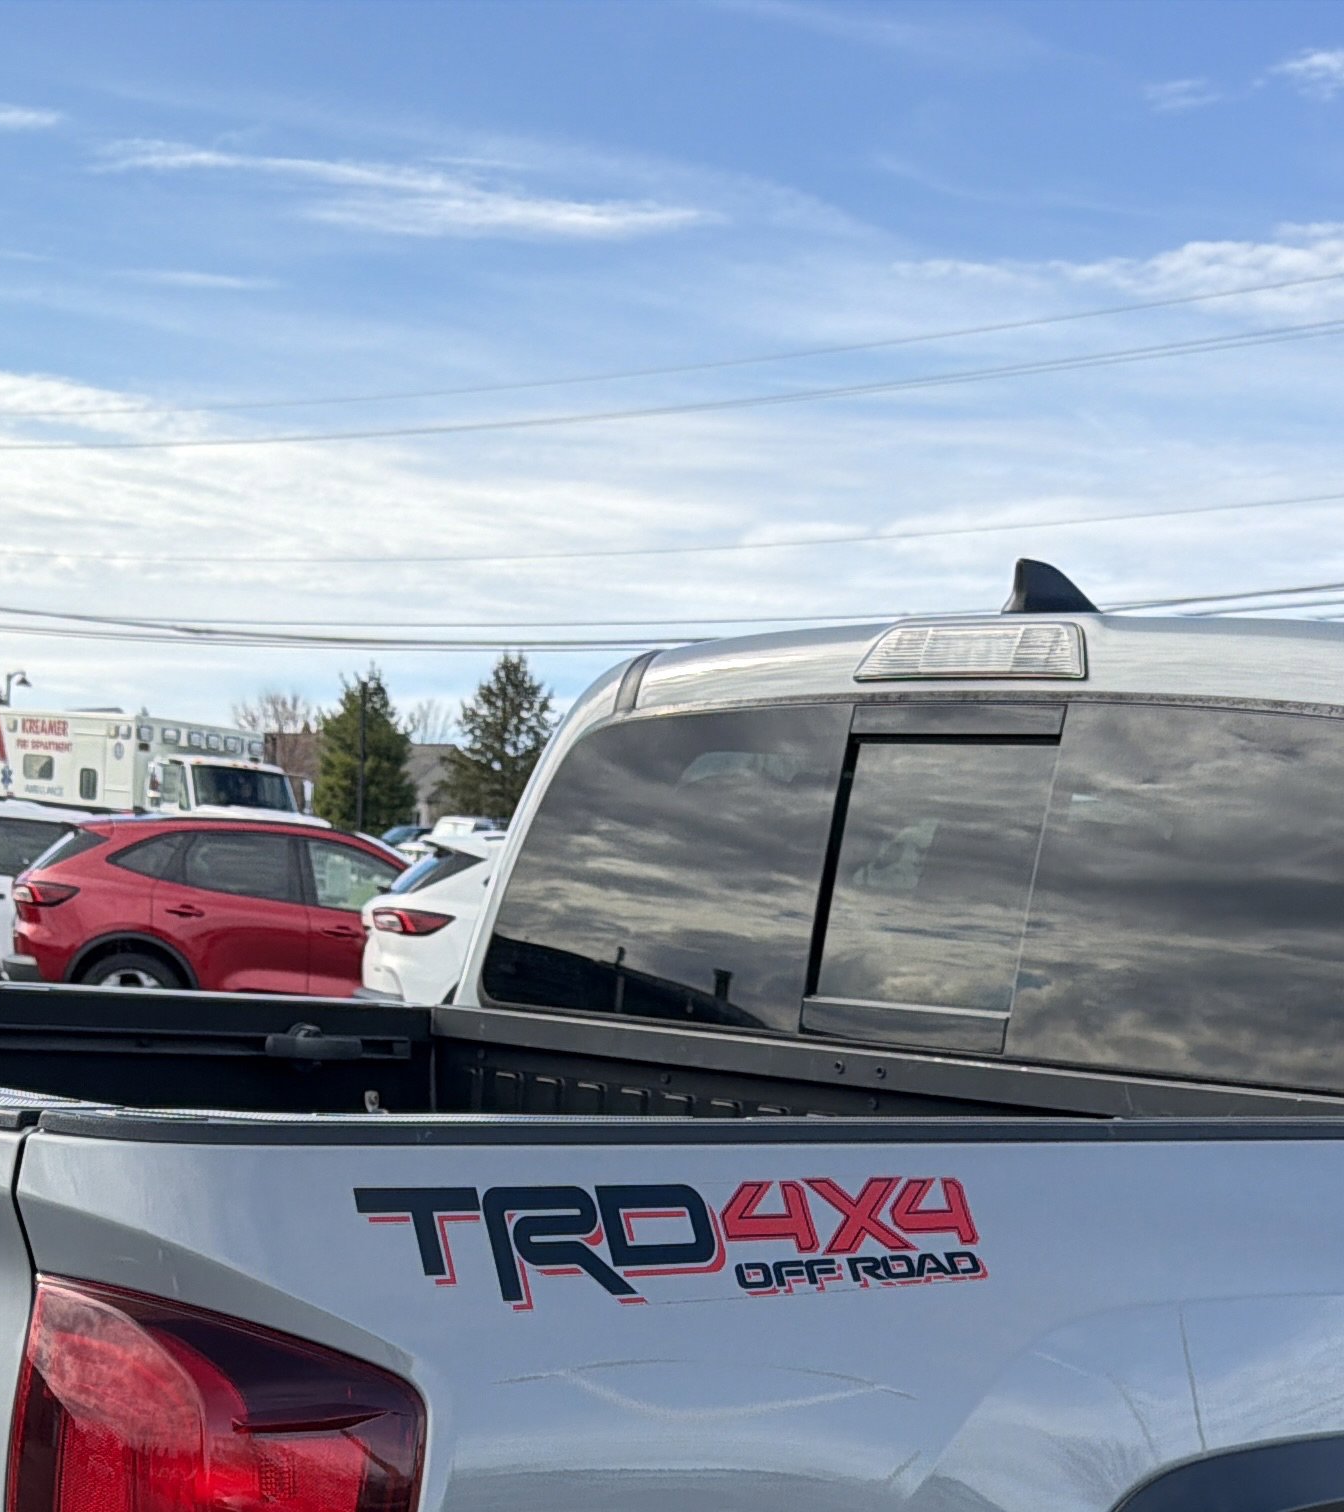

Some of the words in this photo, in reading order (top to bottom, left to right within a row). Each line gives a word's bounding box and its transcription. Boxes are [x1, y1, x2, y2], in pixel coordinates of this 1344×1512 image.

[21, 718, 69, 737] KREAMER
[353, 1184, 726, 1312] TRD
[720, 1176, 979, 1255] 4X4
[735, 1256, 843, 1296] OFF
[846, 1251, 988, 1288] ROAD
